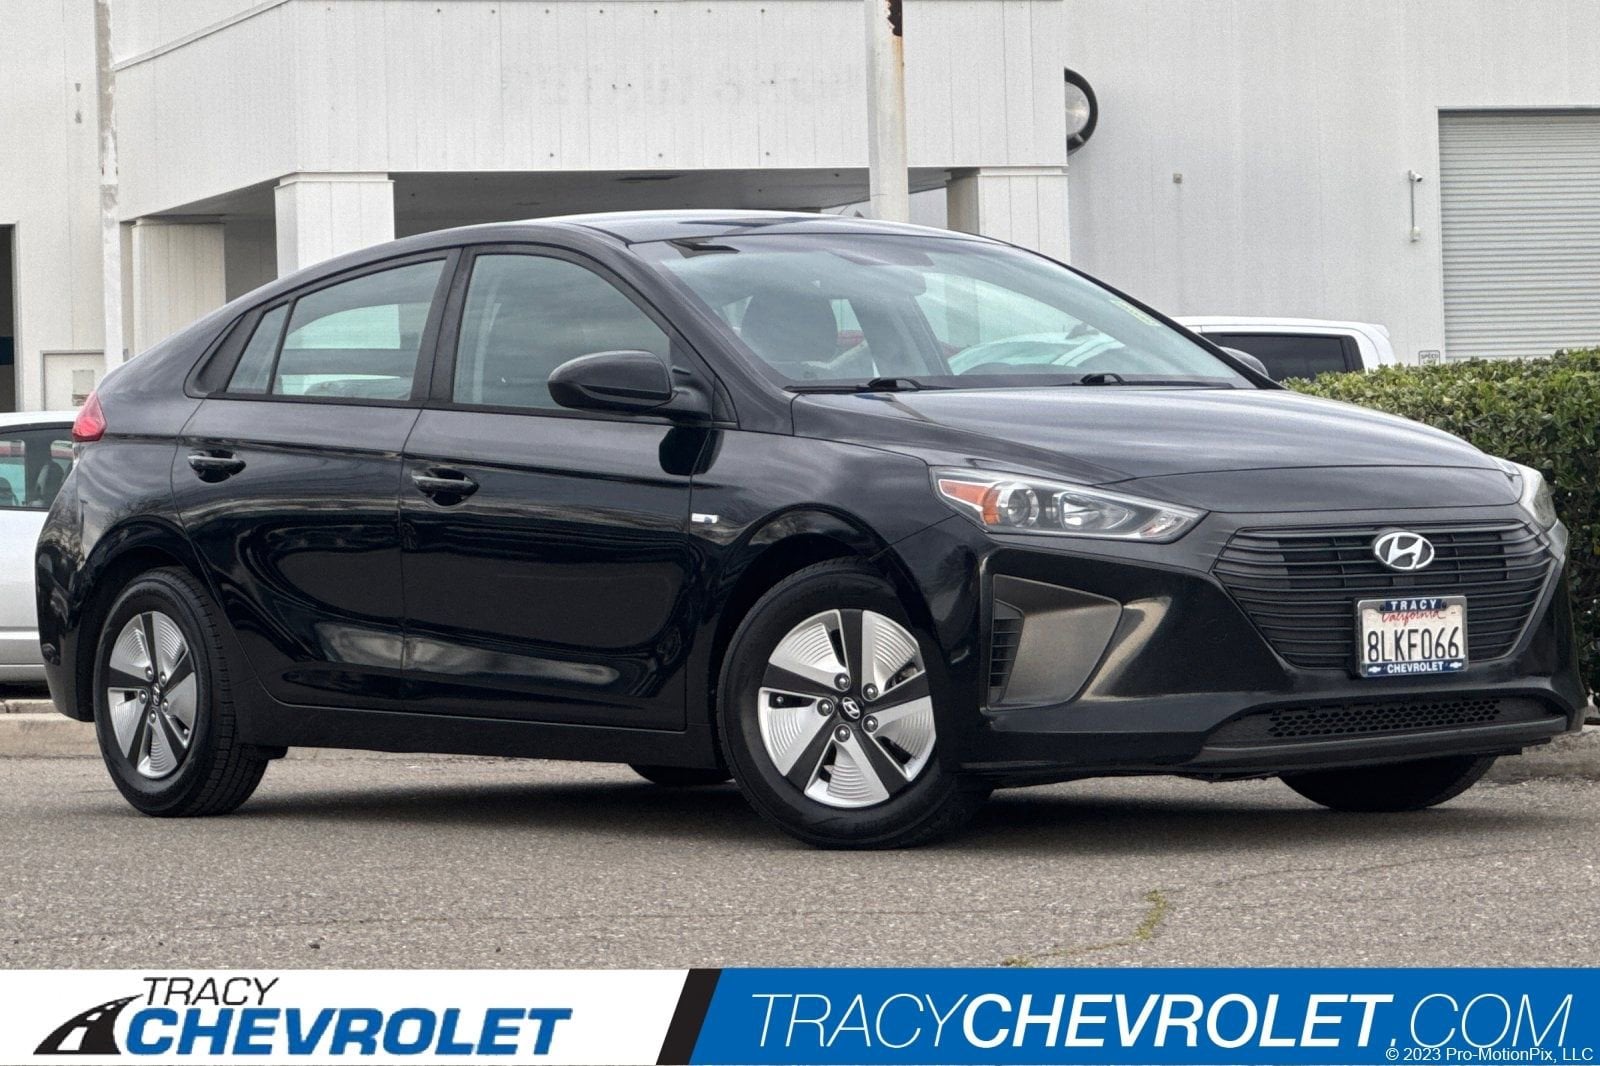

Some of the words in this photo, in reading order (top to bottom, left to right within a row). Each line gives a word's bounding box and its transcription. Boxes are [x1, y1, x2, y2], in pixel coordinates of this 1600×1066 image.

[1391, 600, 1437, 610] TRACY
[1382, 610, 1446, 625] California
[1367, 627, 1459, 662] 8LKF066
[1387, 661, 1443, 673] CHEVROLET
